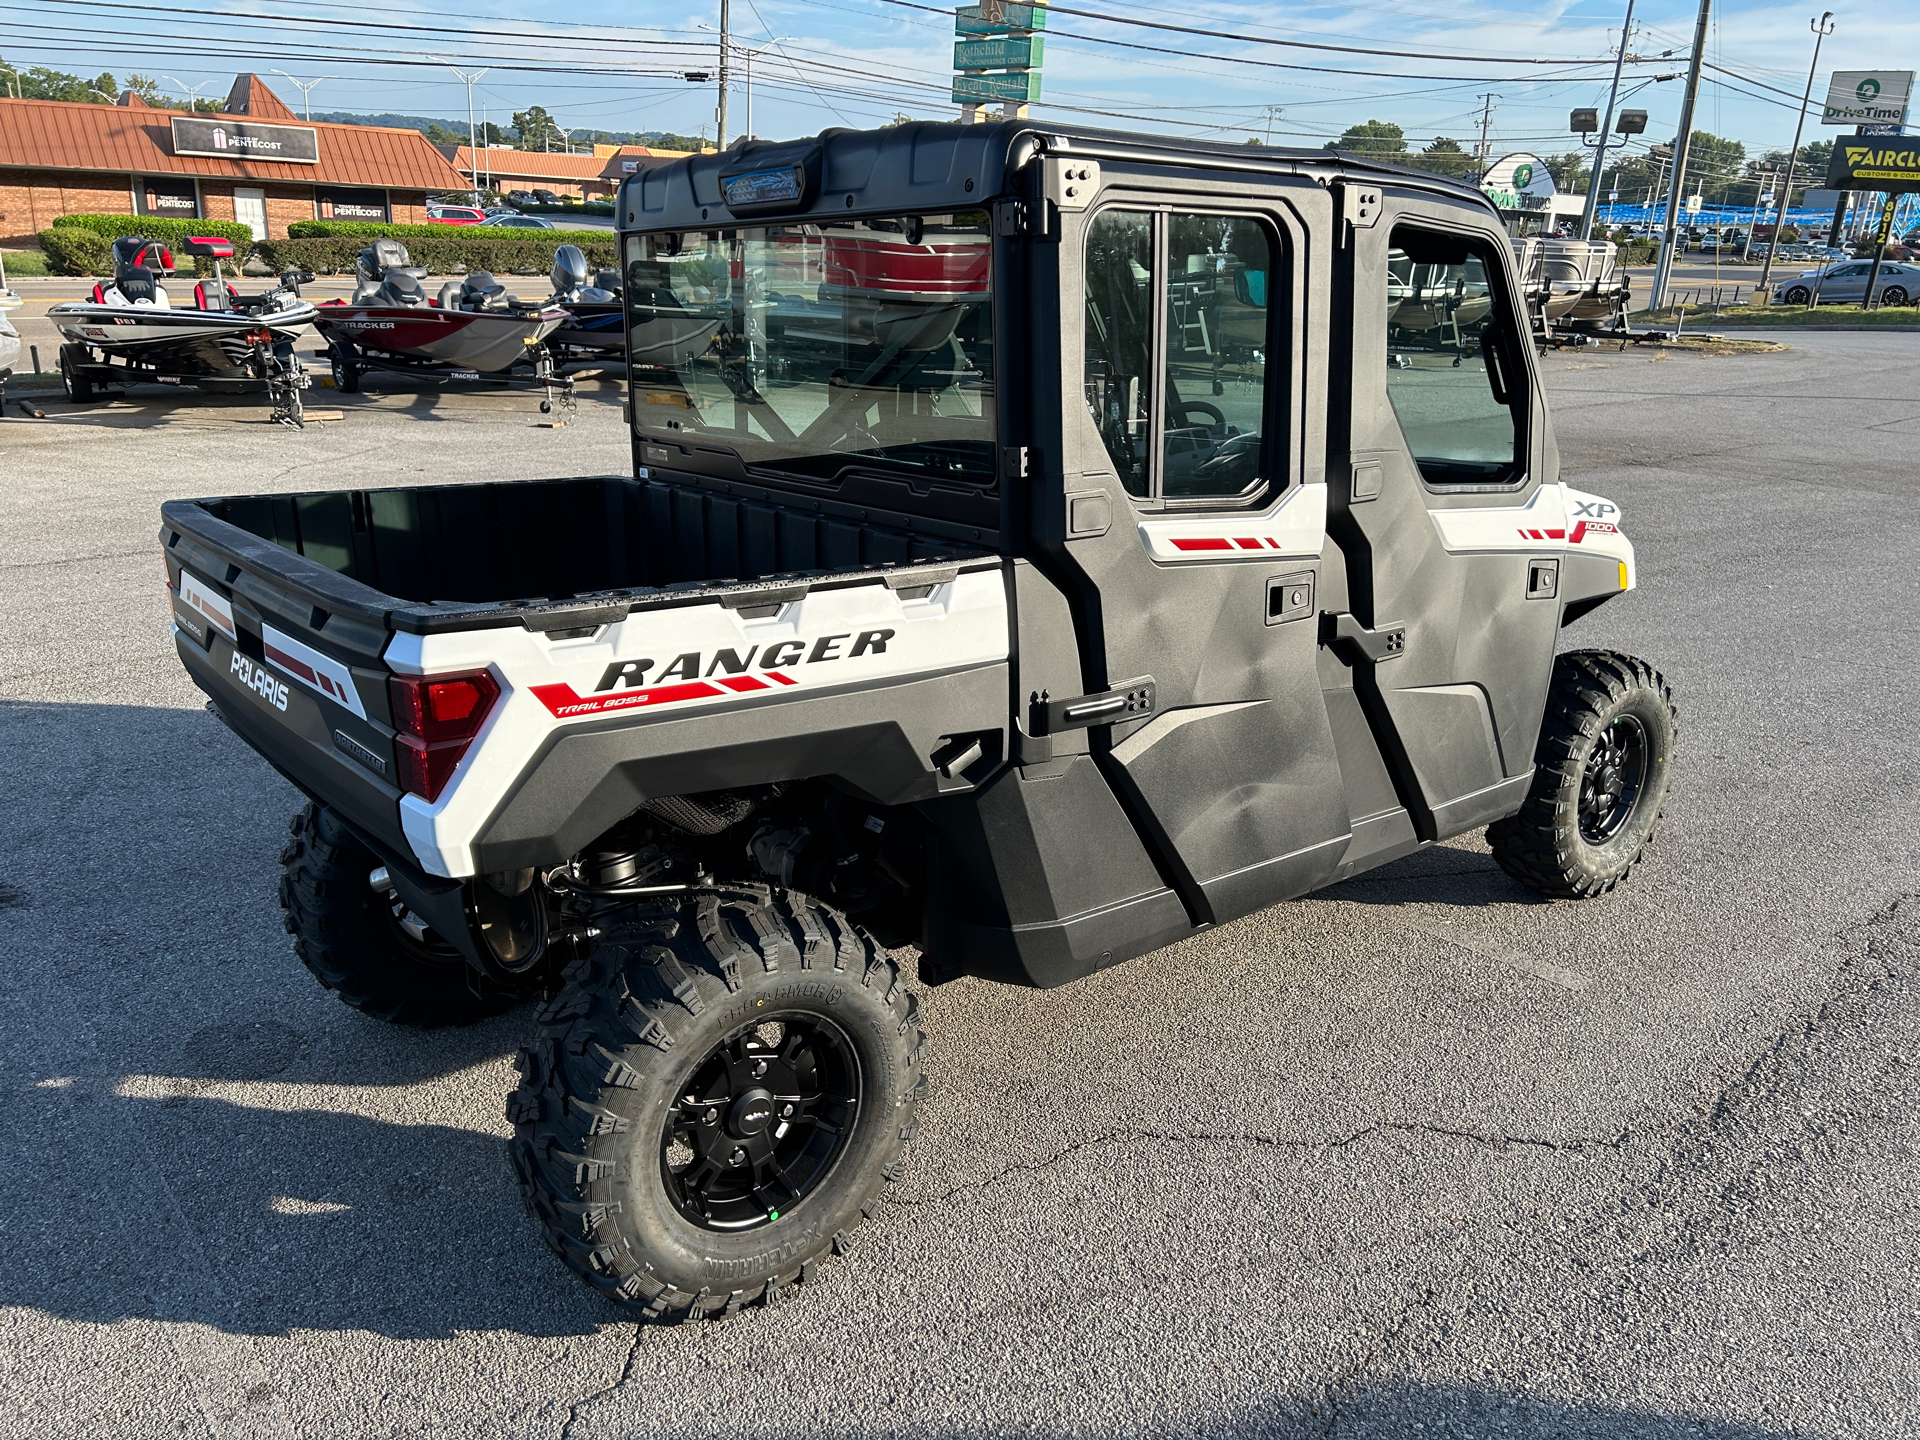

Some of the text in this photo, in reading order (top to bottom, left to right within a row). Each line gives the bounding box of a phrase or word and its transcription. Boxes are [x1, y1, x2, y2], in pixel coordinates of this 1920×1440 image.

[957, 42, 1005, 58] Rothchild
[974, 58, 1006, 66] CONFERENCE
[955, 76, 1026, 90] Event Rentals
[1825, 106, 1901, 119] DriveTime
[228, 138, 282, 150] PENTECOST
[1845, 147, 1920, 167] FAIRCL
[157, 199, 195, 209] PENTECOST
[1484, 187, 1552, 212] DriveTime
[334, 207, 382, 217] PENTECOST
[1875, 201, 1895, 244] 8812
[1572, 500, 1616, 518] XP
[1585, 522, 1613, 532] 1000
[593, 628, 896, 692] RANGER
[230, 650, 289, 711] POLARIS
[556, 694, 649, 715] TRAIL BOSS
[335, 732, 381, 768] NORTHSTAR
[699, 1221, 824, 1281] X-TERRAIN
